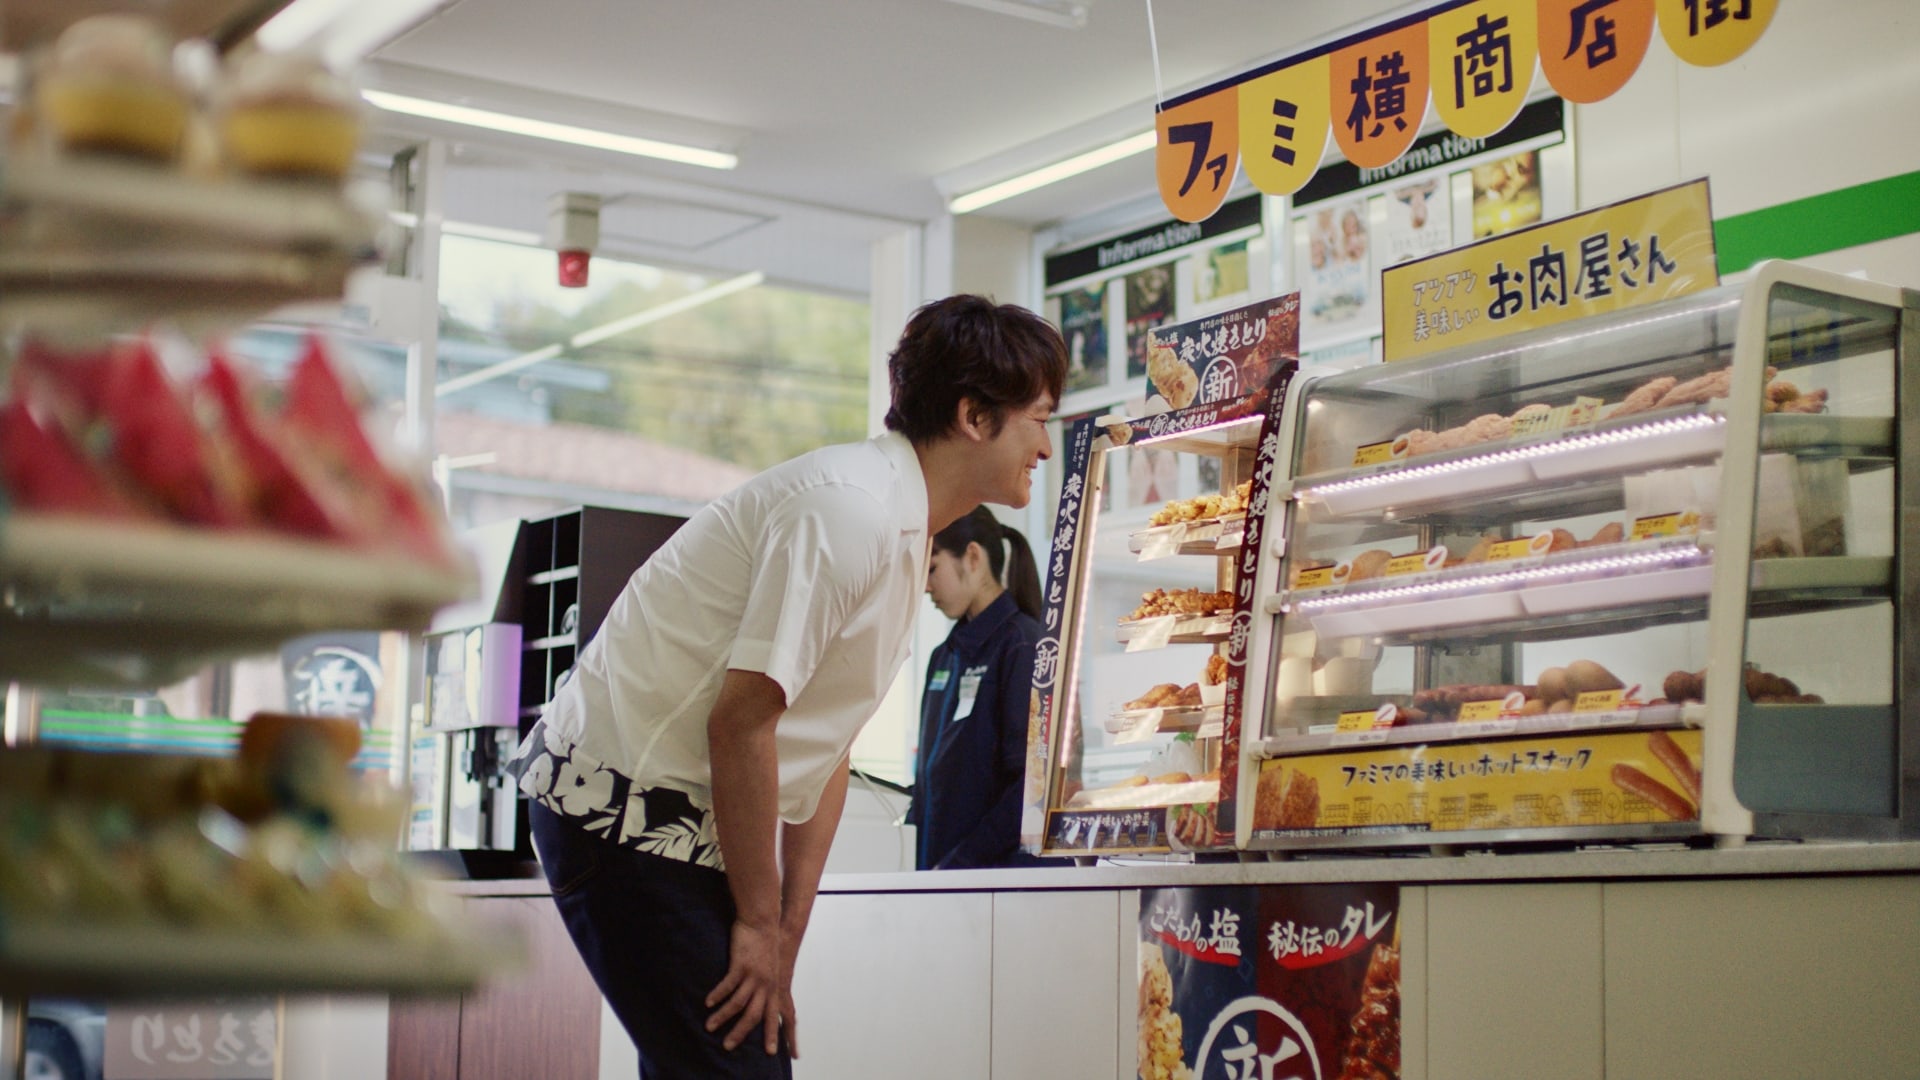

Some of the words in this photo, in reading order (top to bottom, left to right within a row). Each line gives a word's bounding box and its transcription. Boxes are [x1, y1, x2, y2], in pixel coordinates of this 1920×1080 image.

[1097, 222, 1203, 267] Information
[1412, 269, 1478, 307] アツアツ
[1487, 232, 1677, 321] お肉屋さん
[1179, 317, 1267, 363] 炭火焼きとり
[1413, 307, 1480, 342] 美味しい
[1205, 365, 1233, 402] 新
[1239, 431, 1278, 606] 炭火焼きとり
[1044, 472, 1083, 632] 炭火焼きとり
[1032, 643, 1059, 681] 新
[1341, 748, 1593, 786] ファミマの美味しいホットスナック
[1150, 906, 1243, 957] こだわりの塩
[1267, 900, 1393, 960] 秘伝のタレ
